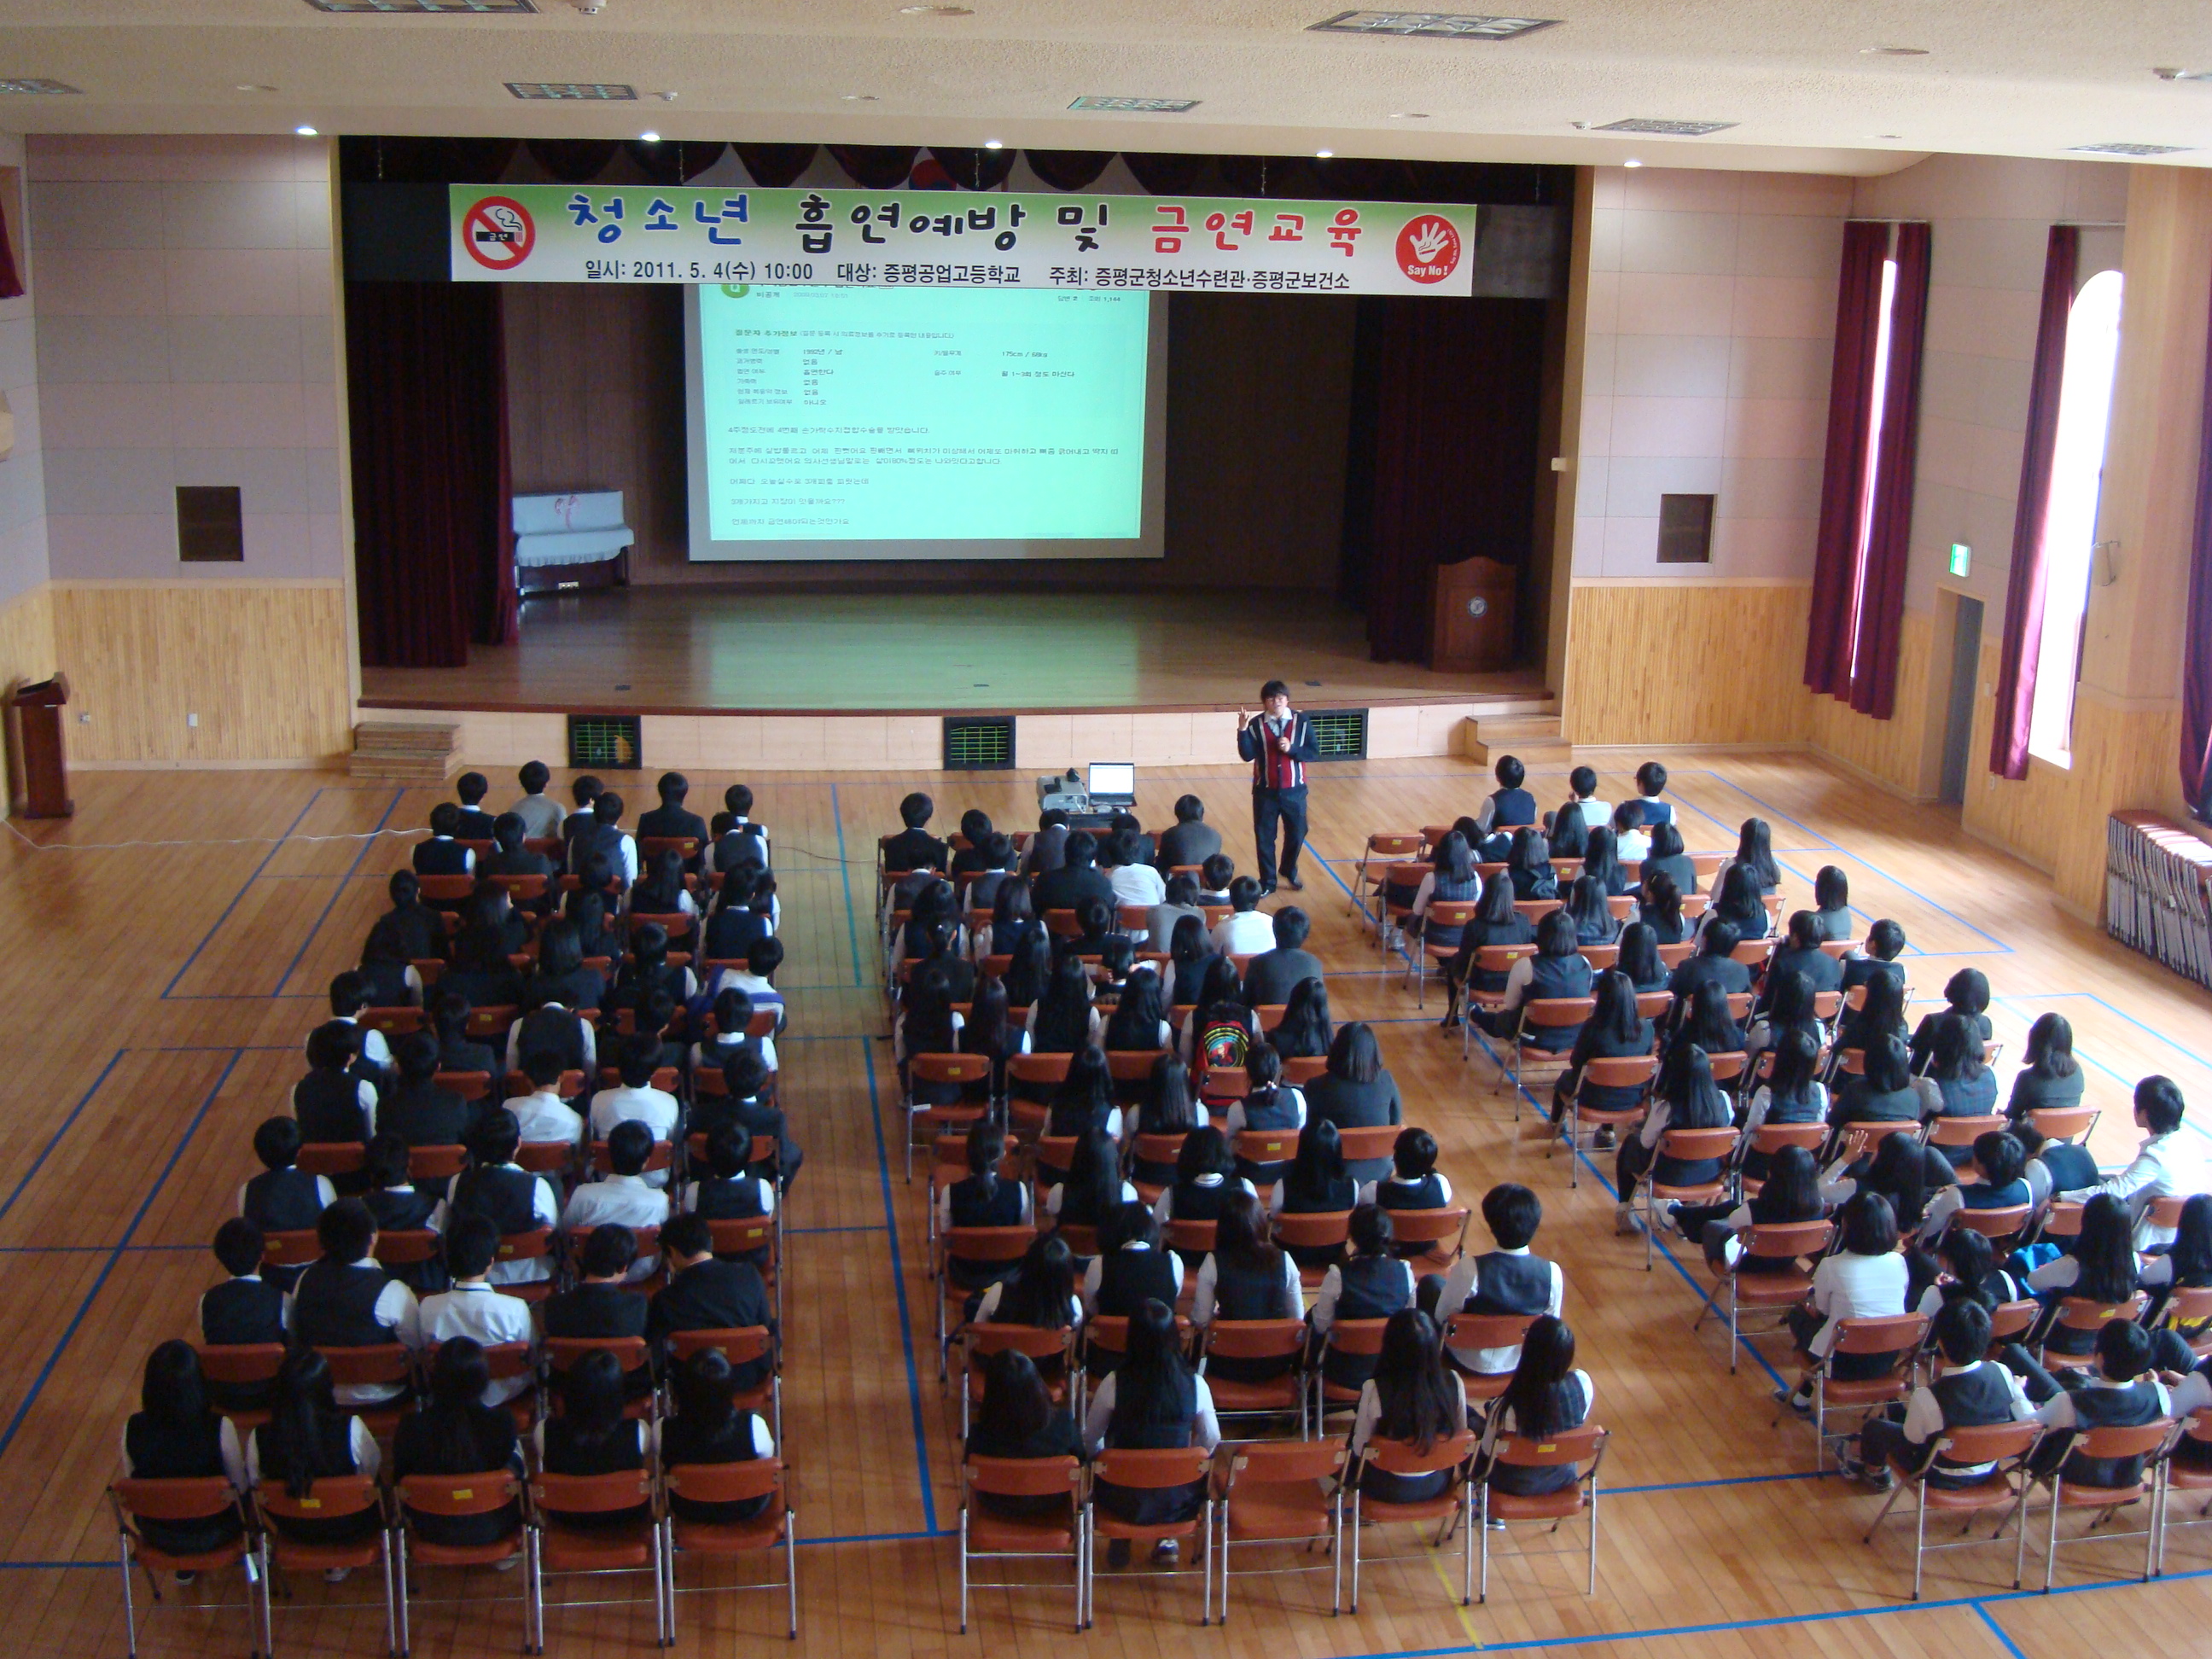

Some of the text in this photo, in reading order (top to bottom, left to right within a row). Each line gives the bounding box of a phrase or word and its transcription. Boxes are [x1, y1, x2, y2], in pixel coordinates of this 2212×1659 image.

[568, 194, 1363, 256] 청소년 흡연예방 및 금연교육
[585, 259, 626, 279] 일시:
[633, 260, 683, 279] 2011.
[713, 261, 755, 282] 4(수)
[765, 263, 812, 280] 10:00
[837, 264, 877, 282] 대상:
[884, 264, 1021, 283] 증평공업고등학교
[1049, 265, 1088, 286] 주최:
[1407, 265, 1426, 277] Say
